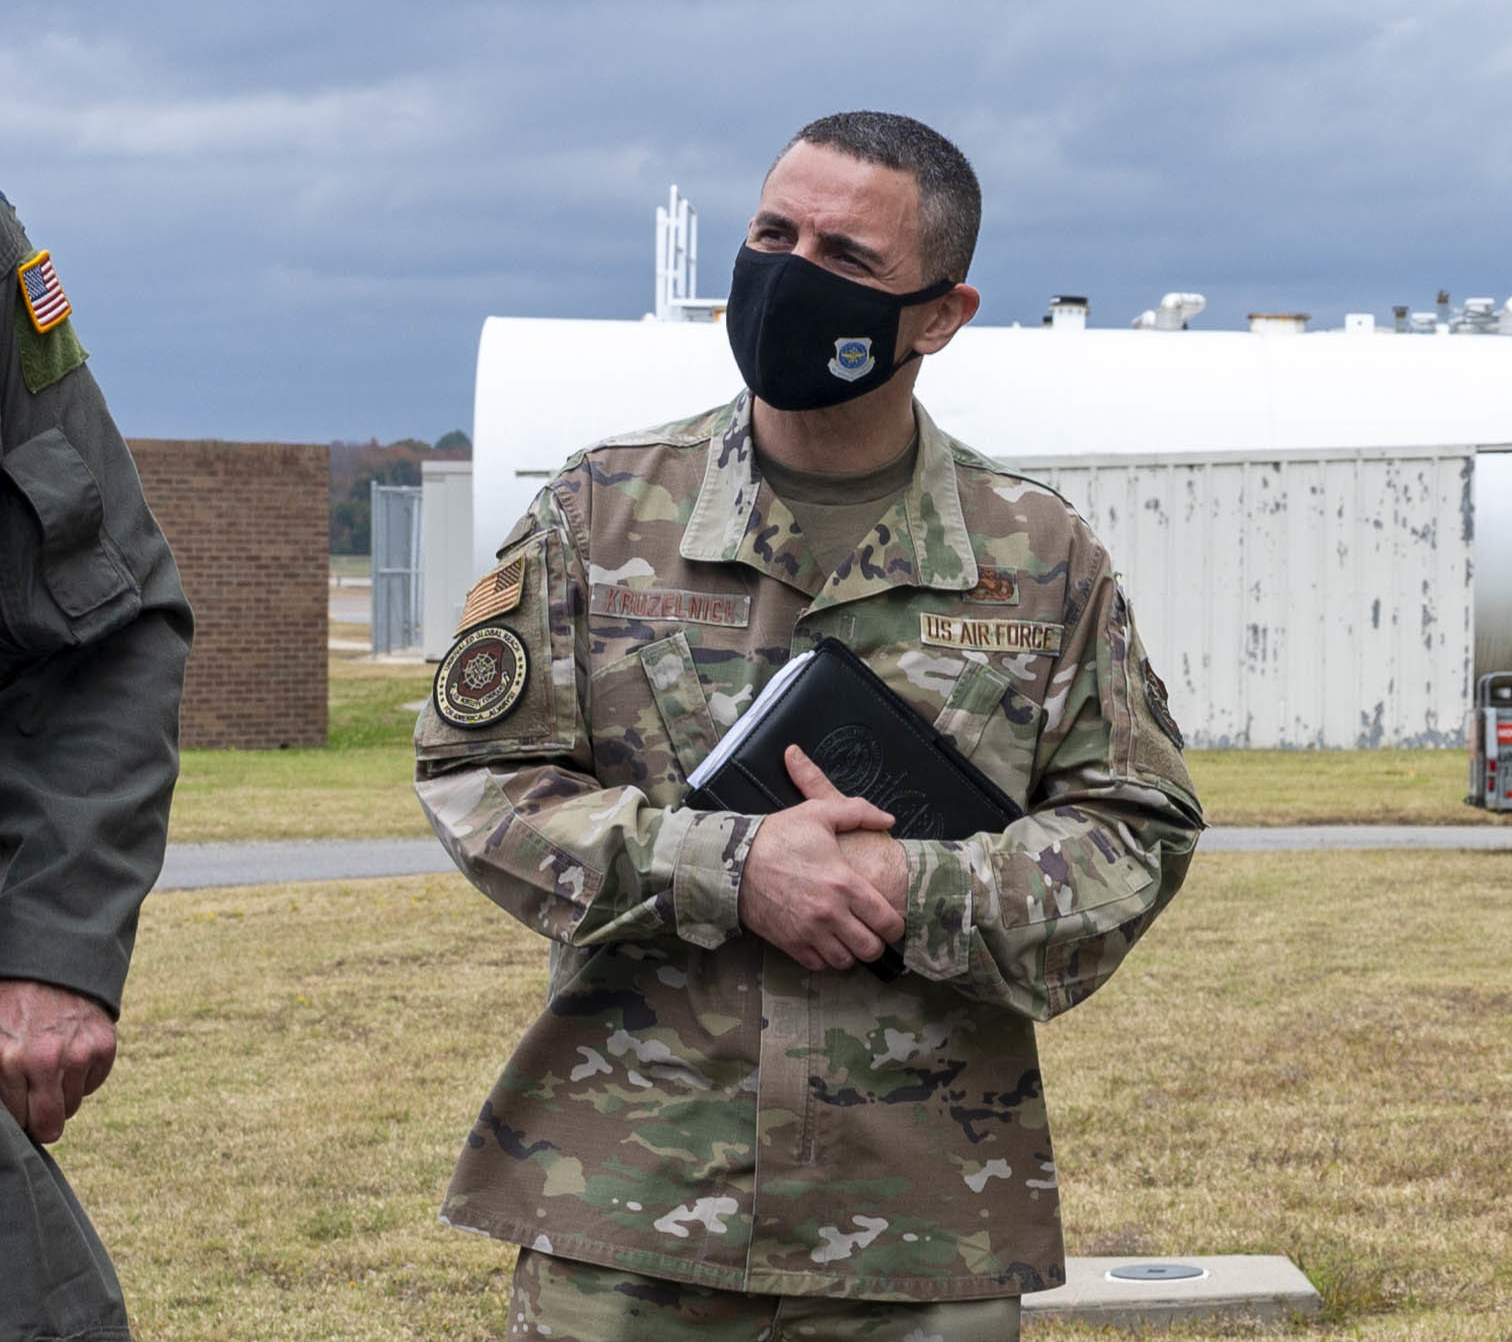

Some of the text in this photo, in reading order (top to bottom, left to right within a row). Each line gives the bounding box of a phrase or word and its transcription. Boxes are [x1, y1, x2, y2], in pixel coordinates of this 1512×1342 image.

[605, 588, 737, 623] KRUZELNICK
[960, 621, 990, 646] AIR
[994, 623, 1055, 649] FORCE
